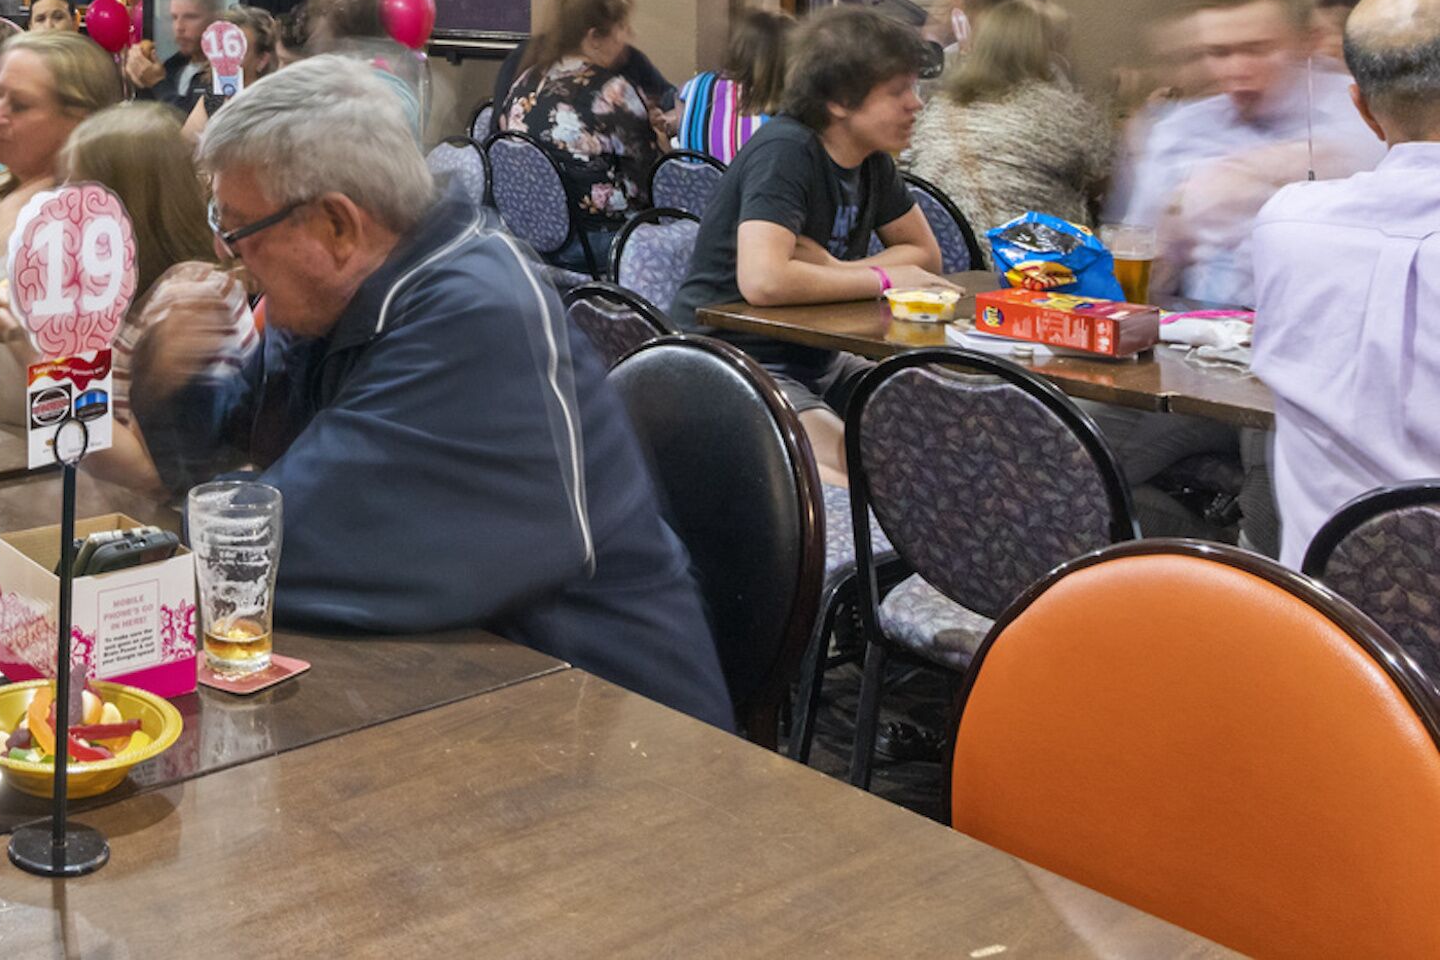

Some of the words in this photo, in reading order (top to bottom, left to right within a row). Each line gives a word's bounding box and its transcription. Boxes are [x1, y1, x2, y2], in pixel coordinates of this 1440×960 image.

[204, 30, 242, 58] 16
[31, 217, 124, 316] 19
[113, 595, 144, 607] MOBILE
[142, 603, 154, 613] GO
[110, 622, 120, 630] IN
